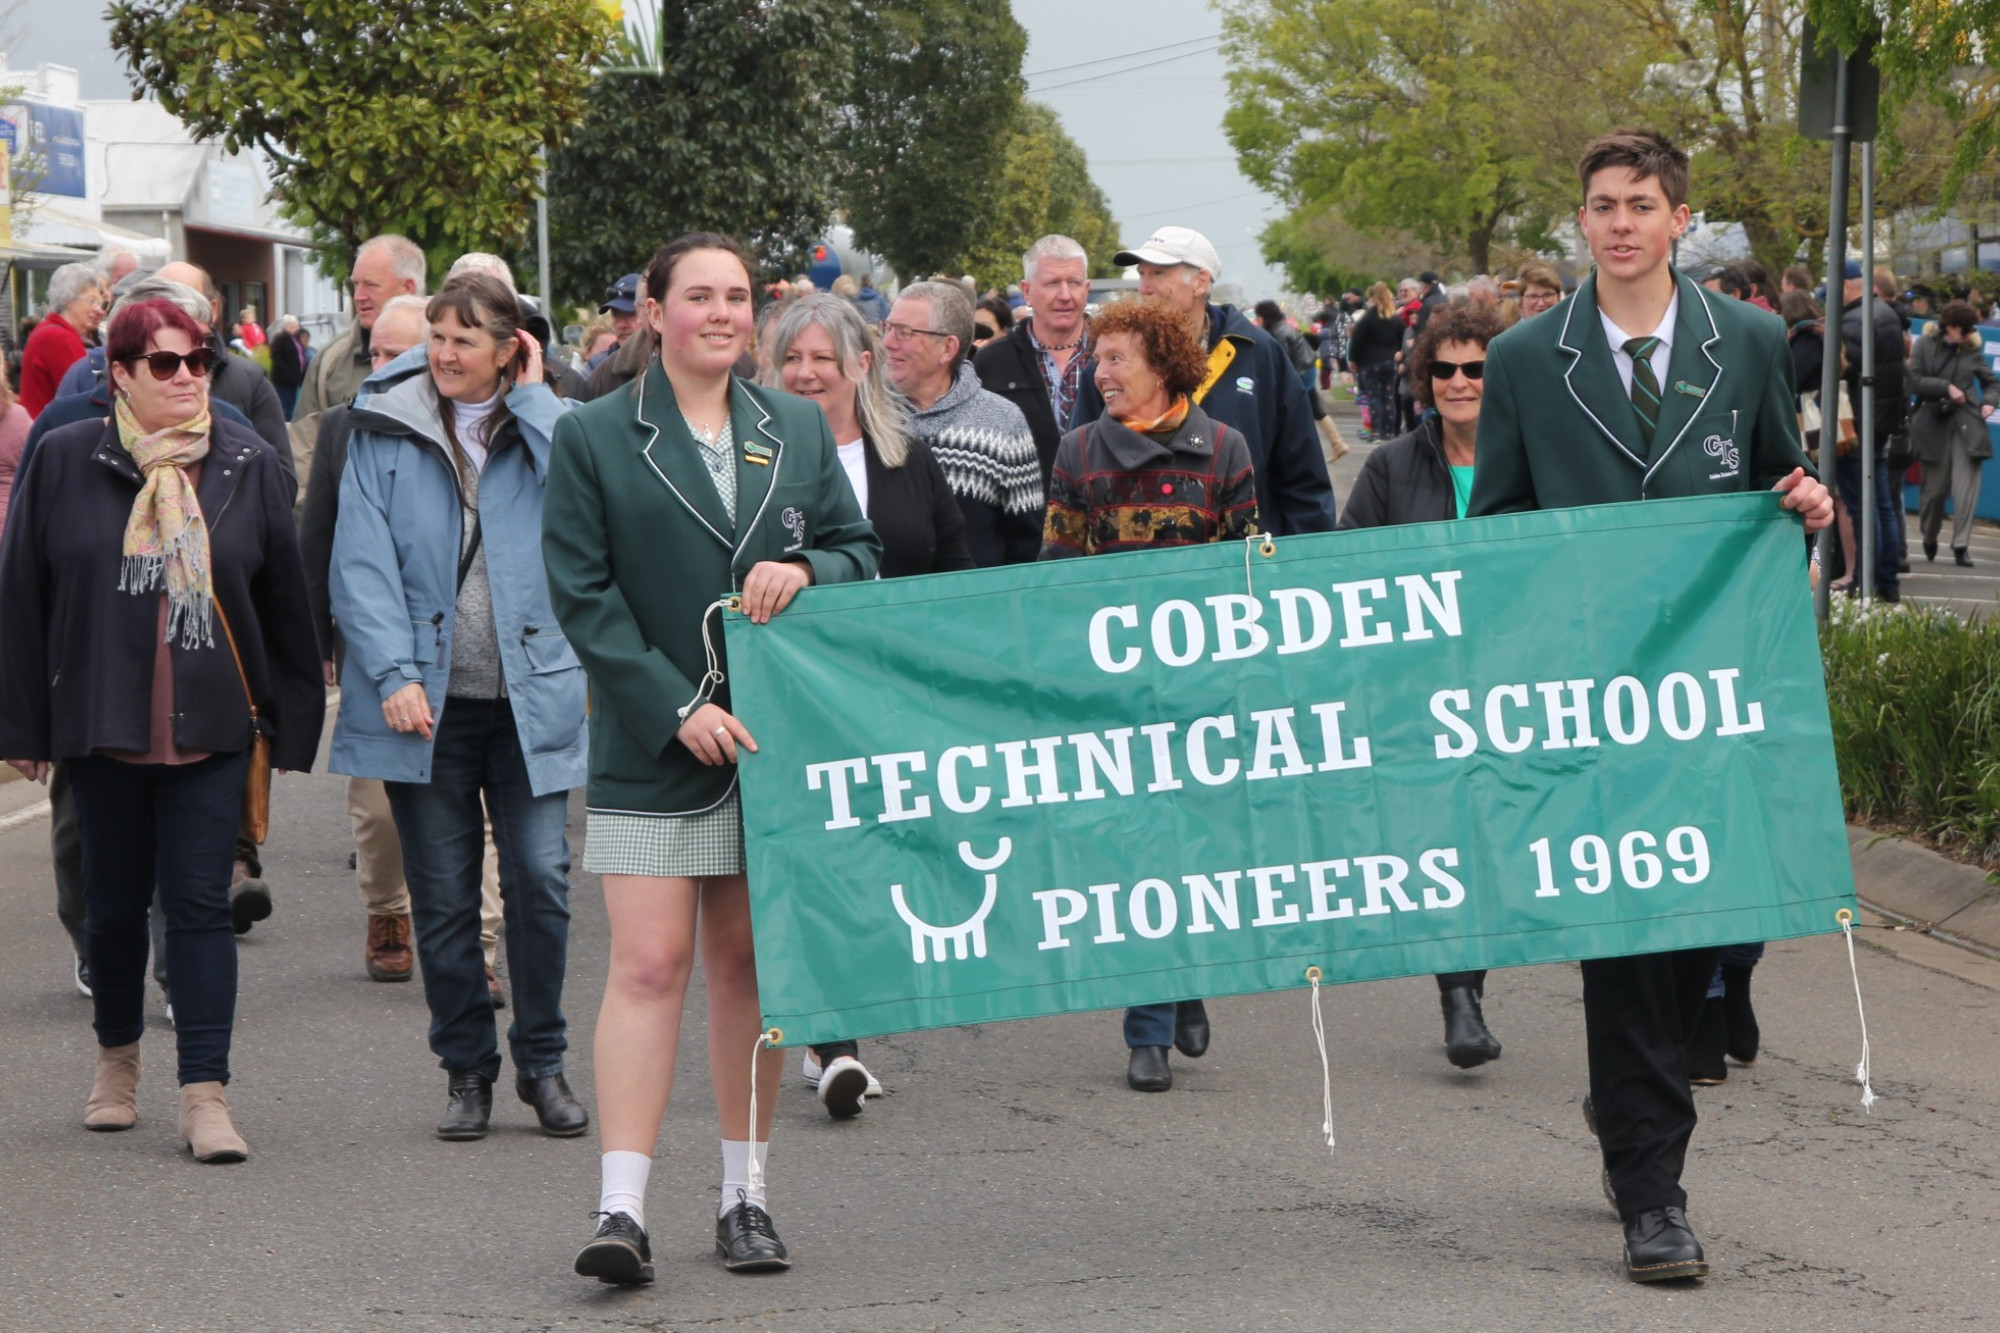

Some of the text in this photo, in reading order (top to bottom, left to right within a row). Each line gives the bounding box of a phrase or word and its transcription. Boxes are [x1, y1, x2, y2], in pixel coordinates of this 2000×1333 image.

[1089, 570, 1462, 674] COBDEN
[806, 668, 1765, 831] TECHNICAL SCHOOL
[1033, 826, 1711, 951] PIONEERS 1969
